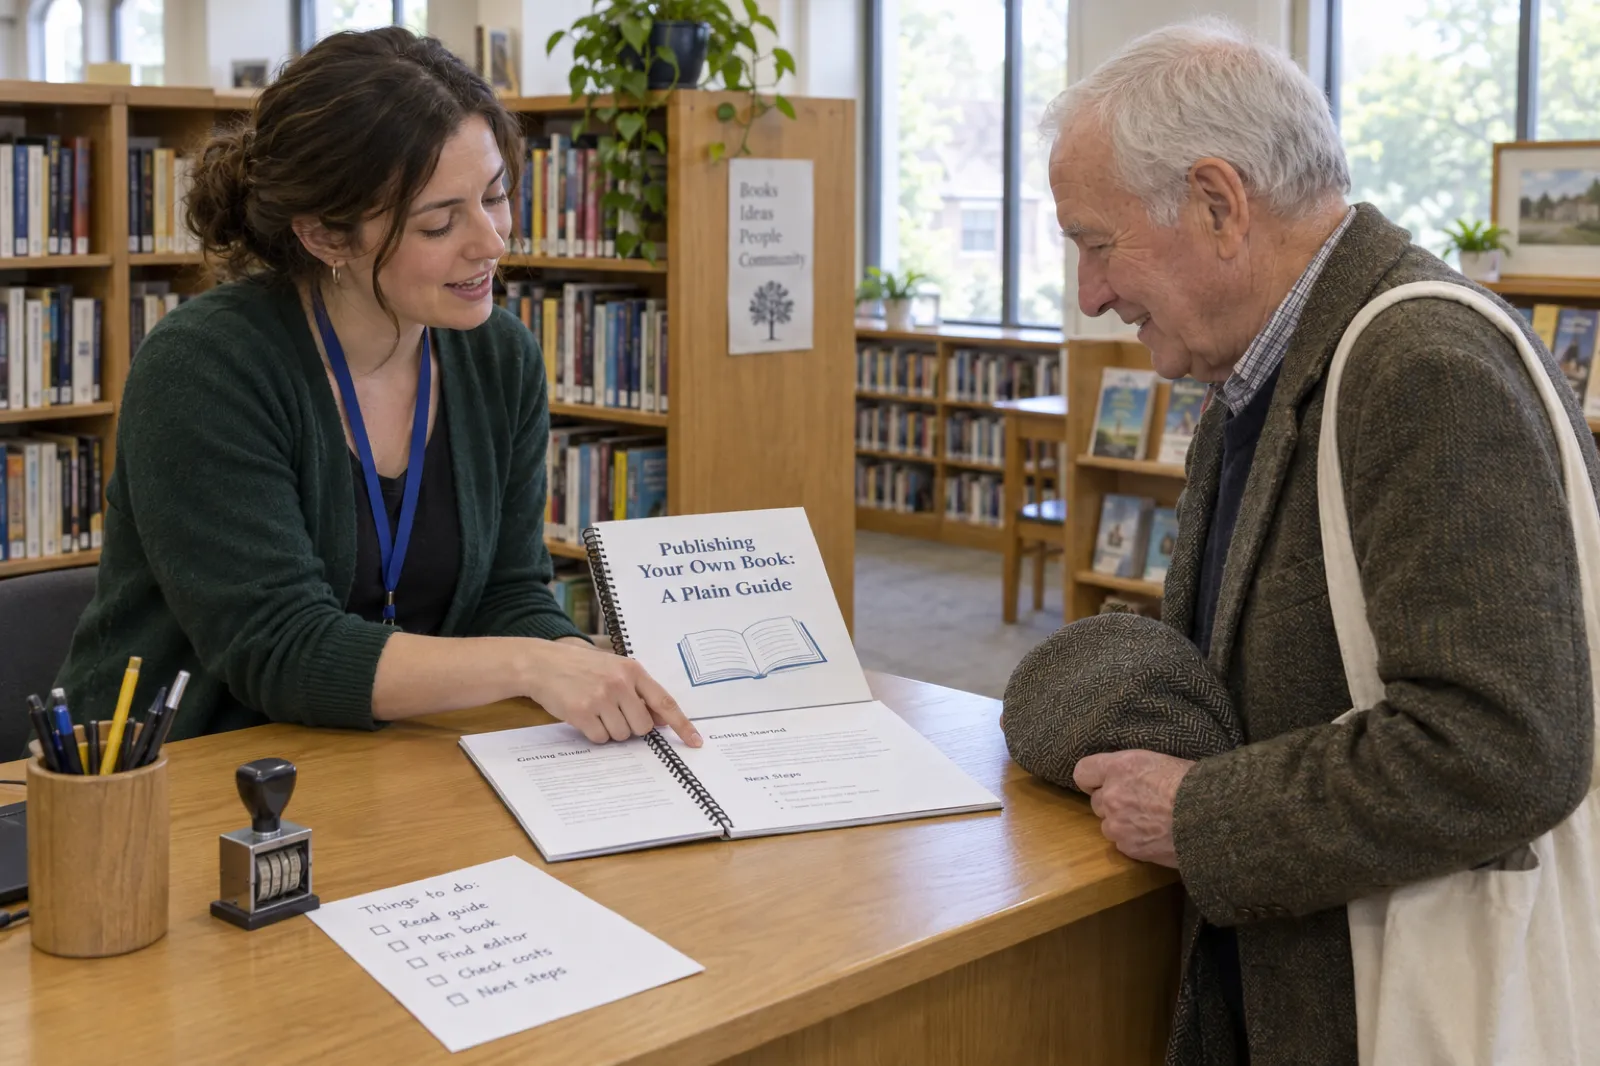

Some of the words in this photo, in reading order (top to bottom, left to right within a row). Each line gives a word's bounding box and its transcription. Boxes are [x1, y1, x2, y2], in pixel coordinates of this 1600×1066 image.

[739, 182, 778, 199] Books
[739, 205, 775, 221] Ideas
[739, 228, 782, 248] People
[738, 252, 806, 270] Community
[658, 537, 756, 556] Publishing
[637, 564, 684, 578] Your
[689, 559, 736, 574] Own
[739, 552, 795, 569] Book:
[661, 589, 677, 603] A
[680, 584, 731, 602] Plain
[735, 578, 793, 596] Guide
[744, 775, 769, 783] Next
[772, 772, 802, 780] Steps
[358, 897, 419, 915] Things
[425, 889, 445, 899] to
[453, 882, 480, 893] do:
[399, 912, 441, 929] Read
[448, 902, 489, 920] guide
[418, 932, 455, 945] Plan
[458, 918, 500, 934] book
[437, 946, 476, 963] Find
[483, 932, 529, 950] editor
[458, 960, 505, 980] Check
[512, 947, 553, 965] costs
[476, 981, 518, 998] Next
[524, 966, 567, 985] steps
